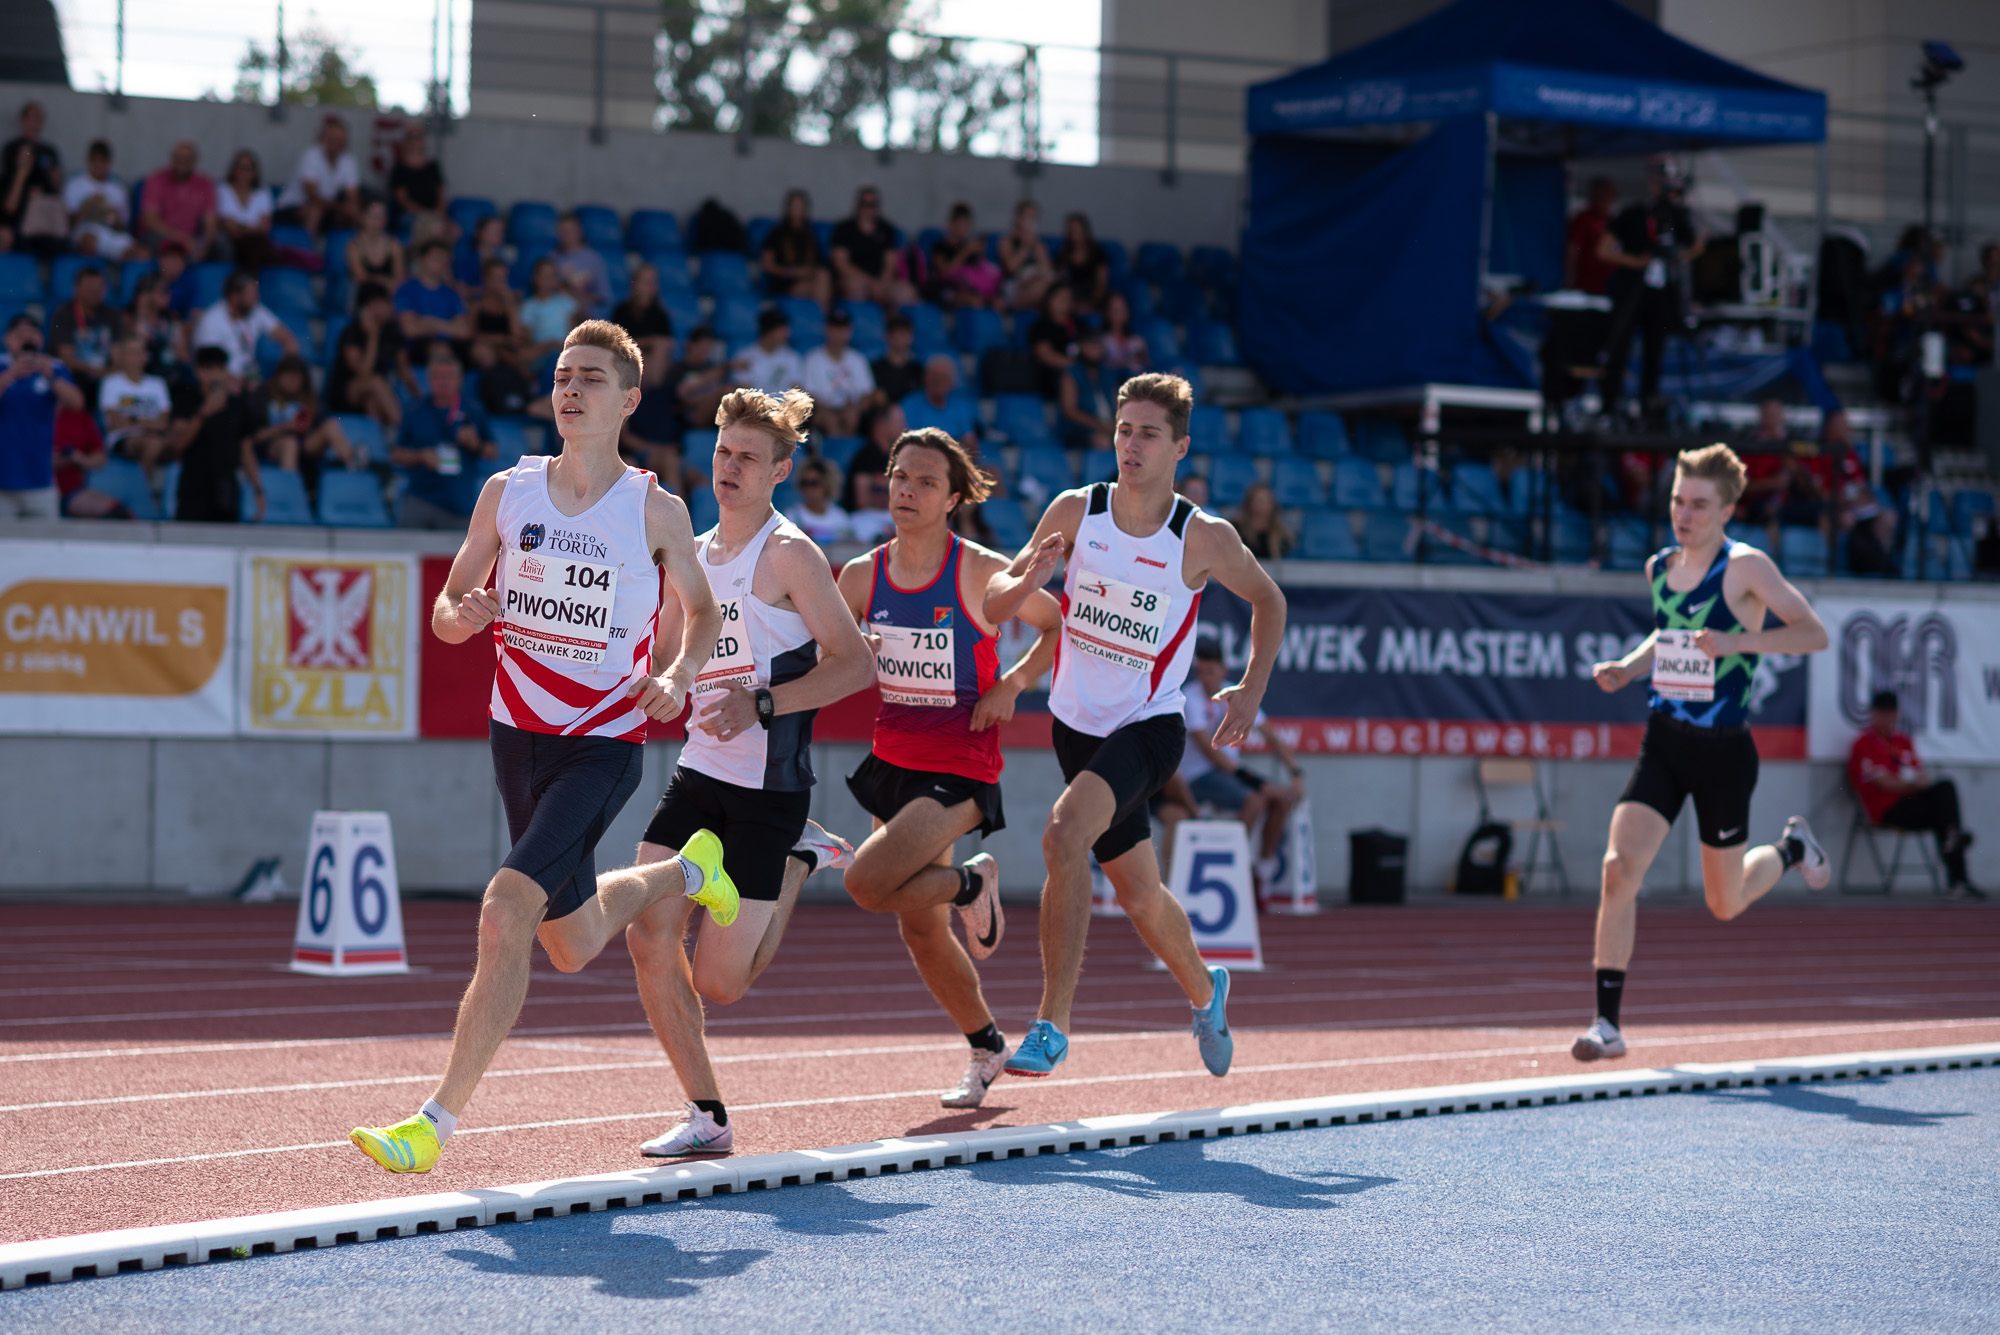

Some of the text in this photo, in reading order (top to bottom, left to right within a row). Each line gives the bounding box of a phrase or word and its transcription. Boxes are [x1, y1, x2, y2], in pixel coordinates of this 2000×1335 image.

[548, 536, 608, 559] TORUŃ
[552, 529, 596, 543] MIASTO
[564, 564, 610, 592] 104
[507, 589, 608, 629] PIWOŃSKI
[1130, 590, 1158, 612] 58
[3, 602, 206, 648] CANWIL S
[1073, 602, 1160, 645] JAWORSKI
[505, 632, 599, 662] WŁOCŁAWEK 2021
[568, 637, 590, 647] POLSKI
[911, 632, 948, 650] 710
[1070, 636, 1125, 664] WŁOCŁAWEK
[1126, 657, 1149, 671] 2021
[1376, 626, 1567, 679] MIASTEM
[1682, 633, 1698, 650] 2
[877, 654, 952, 680] NOWICKI
[262, 676, 393, 719] PZLA
[931, 697, 952, 706] 2021
[309, 843, 335, 936] 6
[352, 844, 388, 937] 6
[1187, 851, 1237, 936] 5
